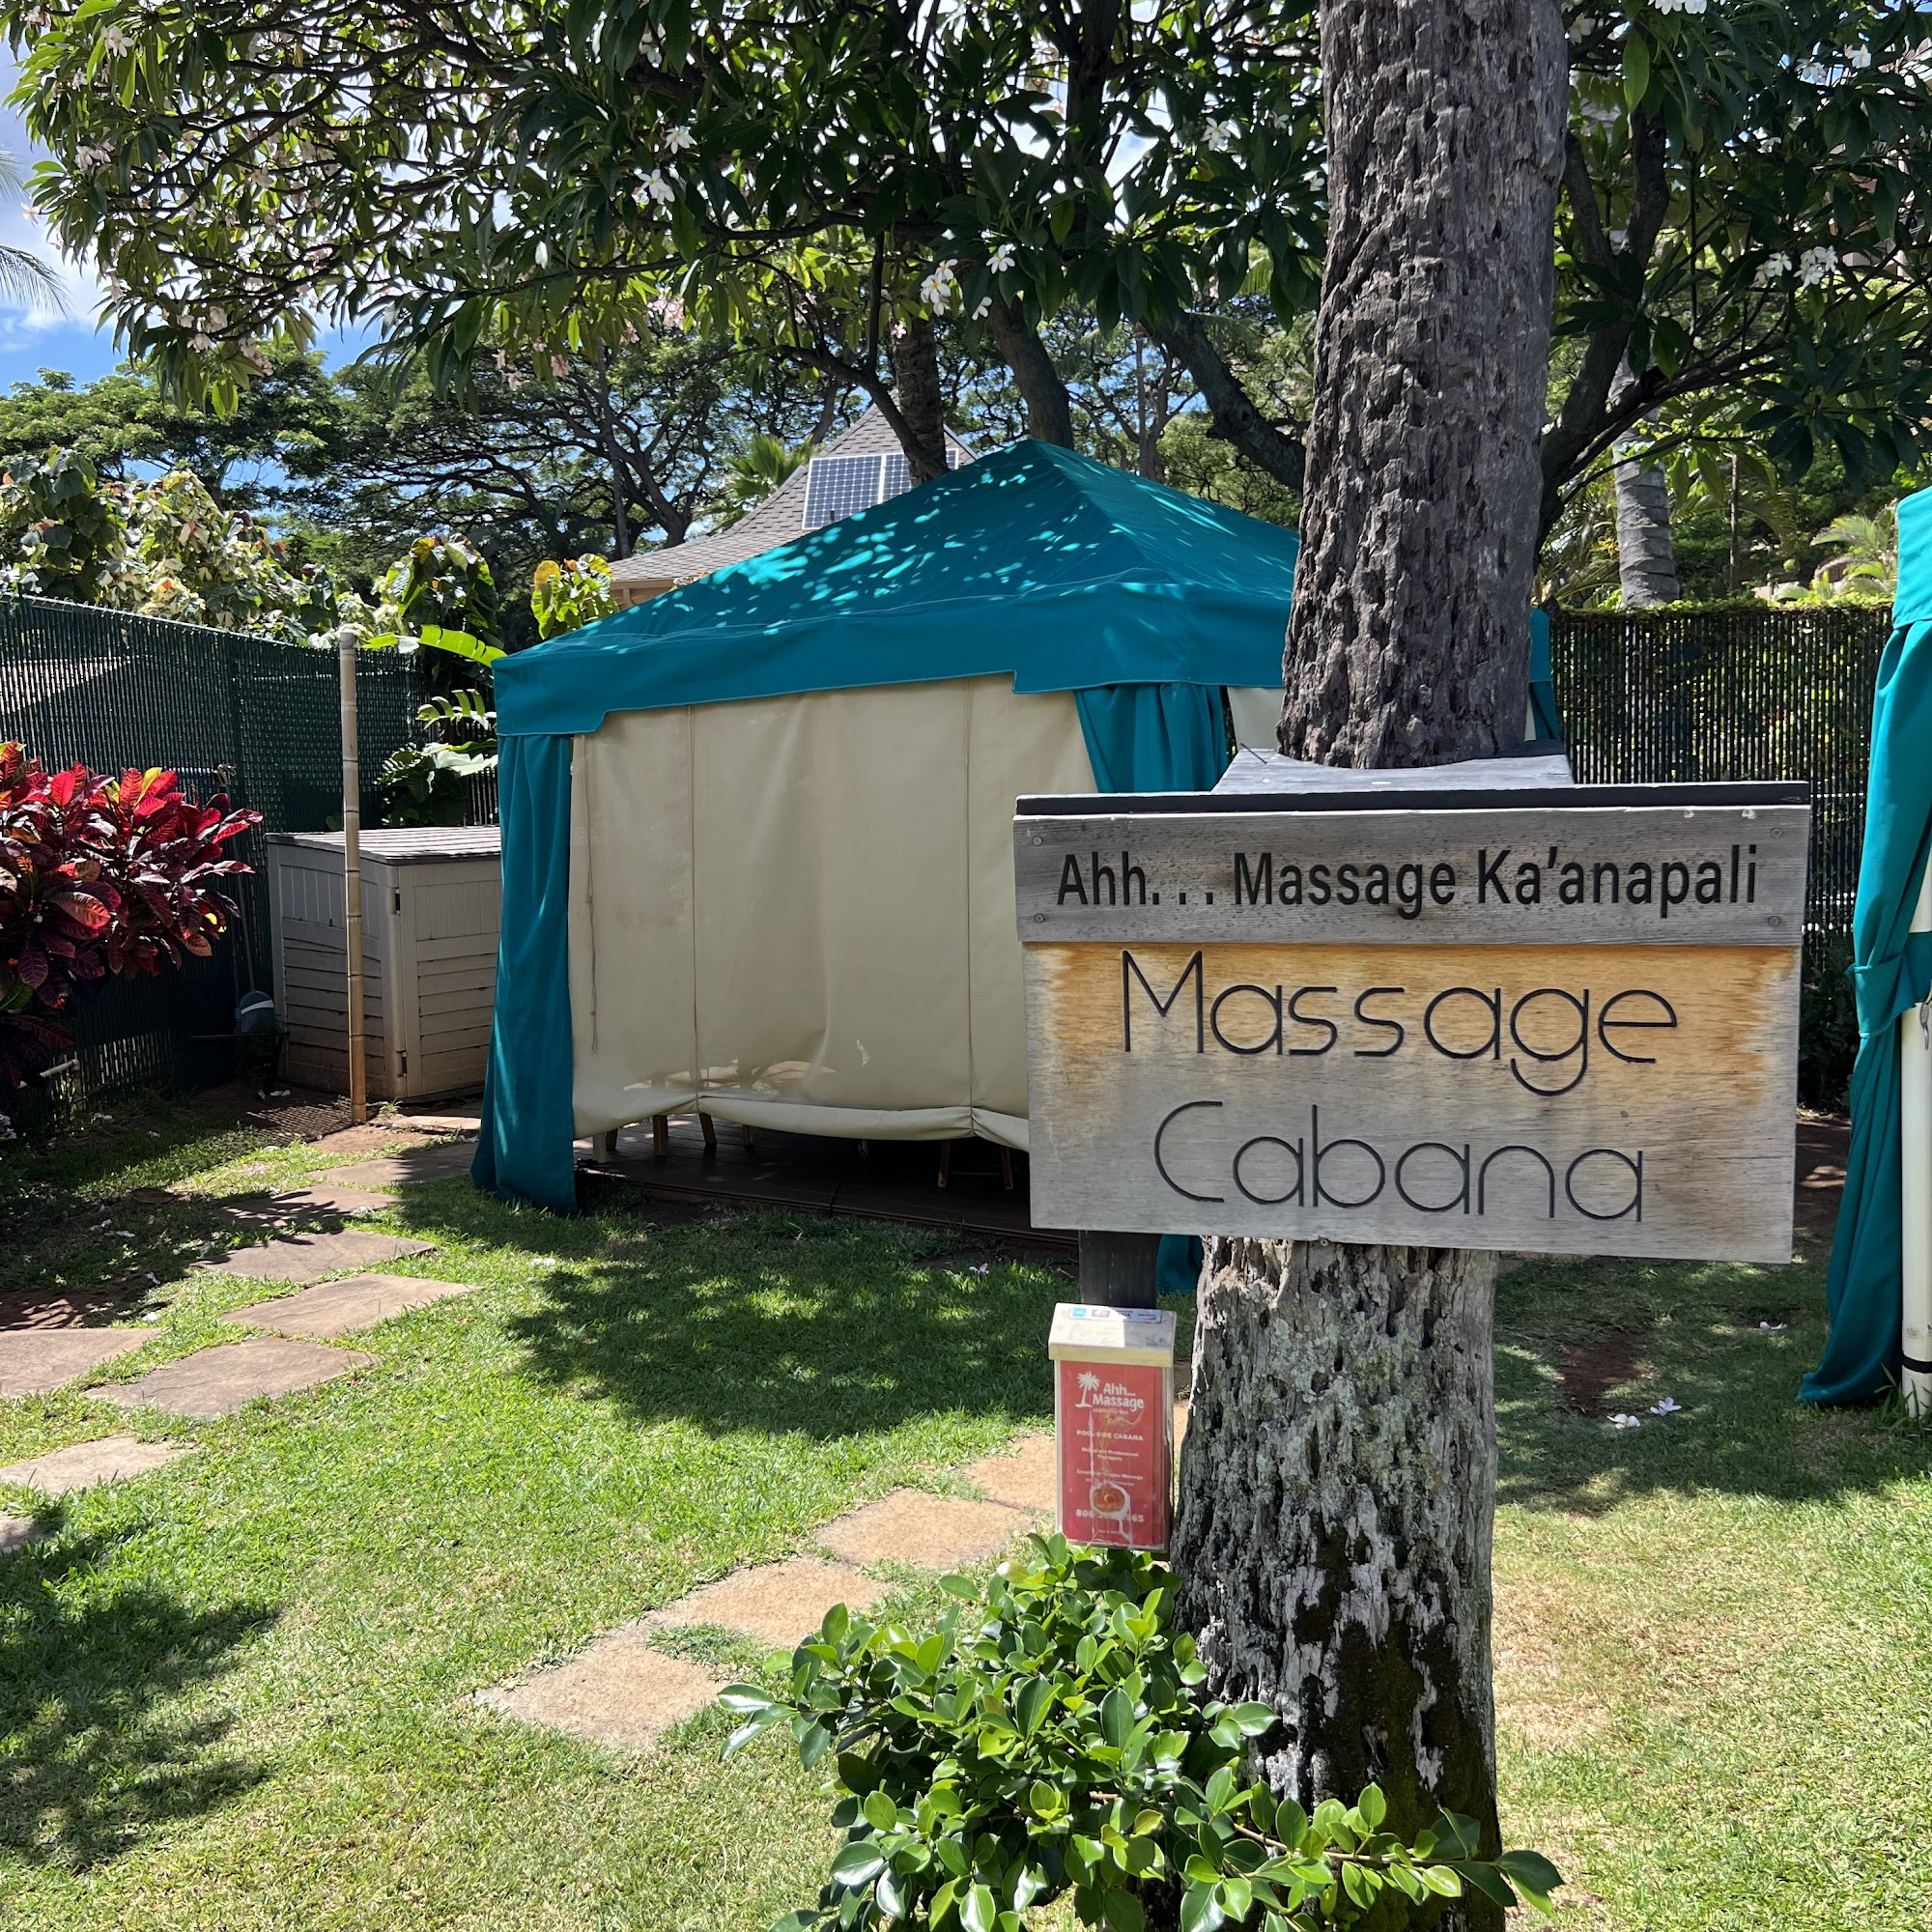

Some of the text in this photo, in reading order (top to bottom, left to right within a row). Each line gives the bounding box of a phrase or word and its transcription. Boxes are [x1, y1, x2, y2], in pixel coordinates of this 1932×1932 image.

[1234, 851, 1456, 920] Massage
[1121, 949, 1678, 1097] Massage
[1153, 1100, 1643, 1223] Cabana
[1093, 1393, 1145, 1412] Massage
[1113, 1433, 1144, 1442] CABANA
